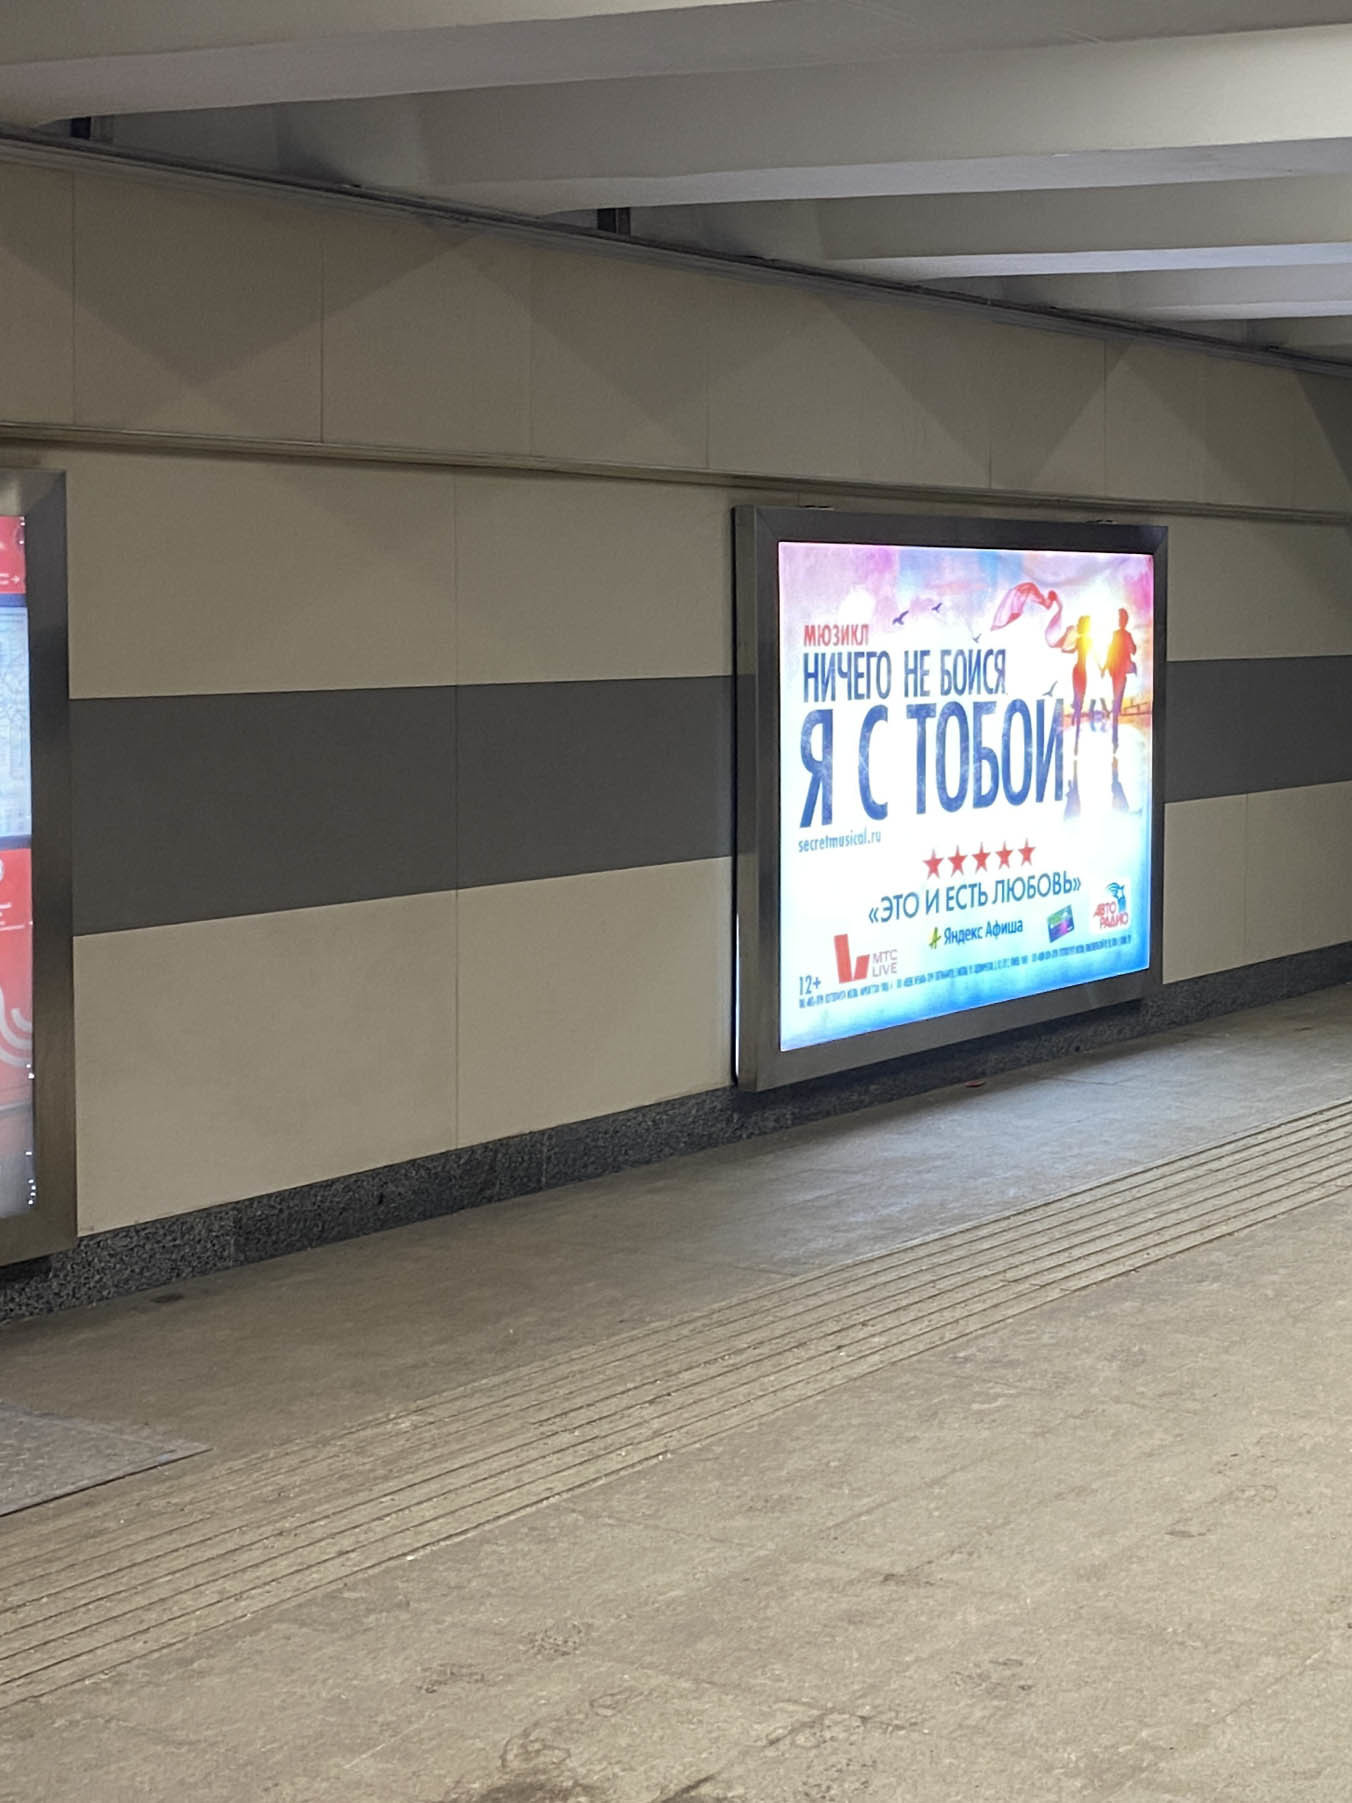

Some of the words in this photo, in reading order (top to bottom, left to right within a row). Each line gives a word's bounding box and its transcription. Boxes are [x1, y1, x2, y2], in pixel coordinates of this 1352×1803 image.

[804, 624, 869, 646] МЮЗИКЛ
[803, 651, 892, 703] НИЧЕГО
[904, 650, 930, 697] НЕ
[800, 708, 834, 828] Я
[858, 704, 889, 821] С
[798, 827, 882, 853] secretmusical.ru
[868, 895, 919, 924] «ЭТО
[926, 889, 940, 915] И
[946, 883, 988, 912] ЕСТЬ
[992, 870, 1081, 905] ЛЮБОВЬ»
[1093, 902, 1117, 918] АВТО
[1100, 911, 1129, 930] РАДИО
[944, 926, 983, 946] Яндекс
[985, 918, 1024, 942] Афиша
[872, 948, 898, 964] МТС
[872, 962, 898, 978] LIVE
[798, 974, 821, 996] 12+
